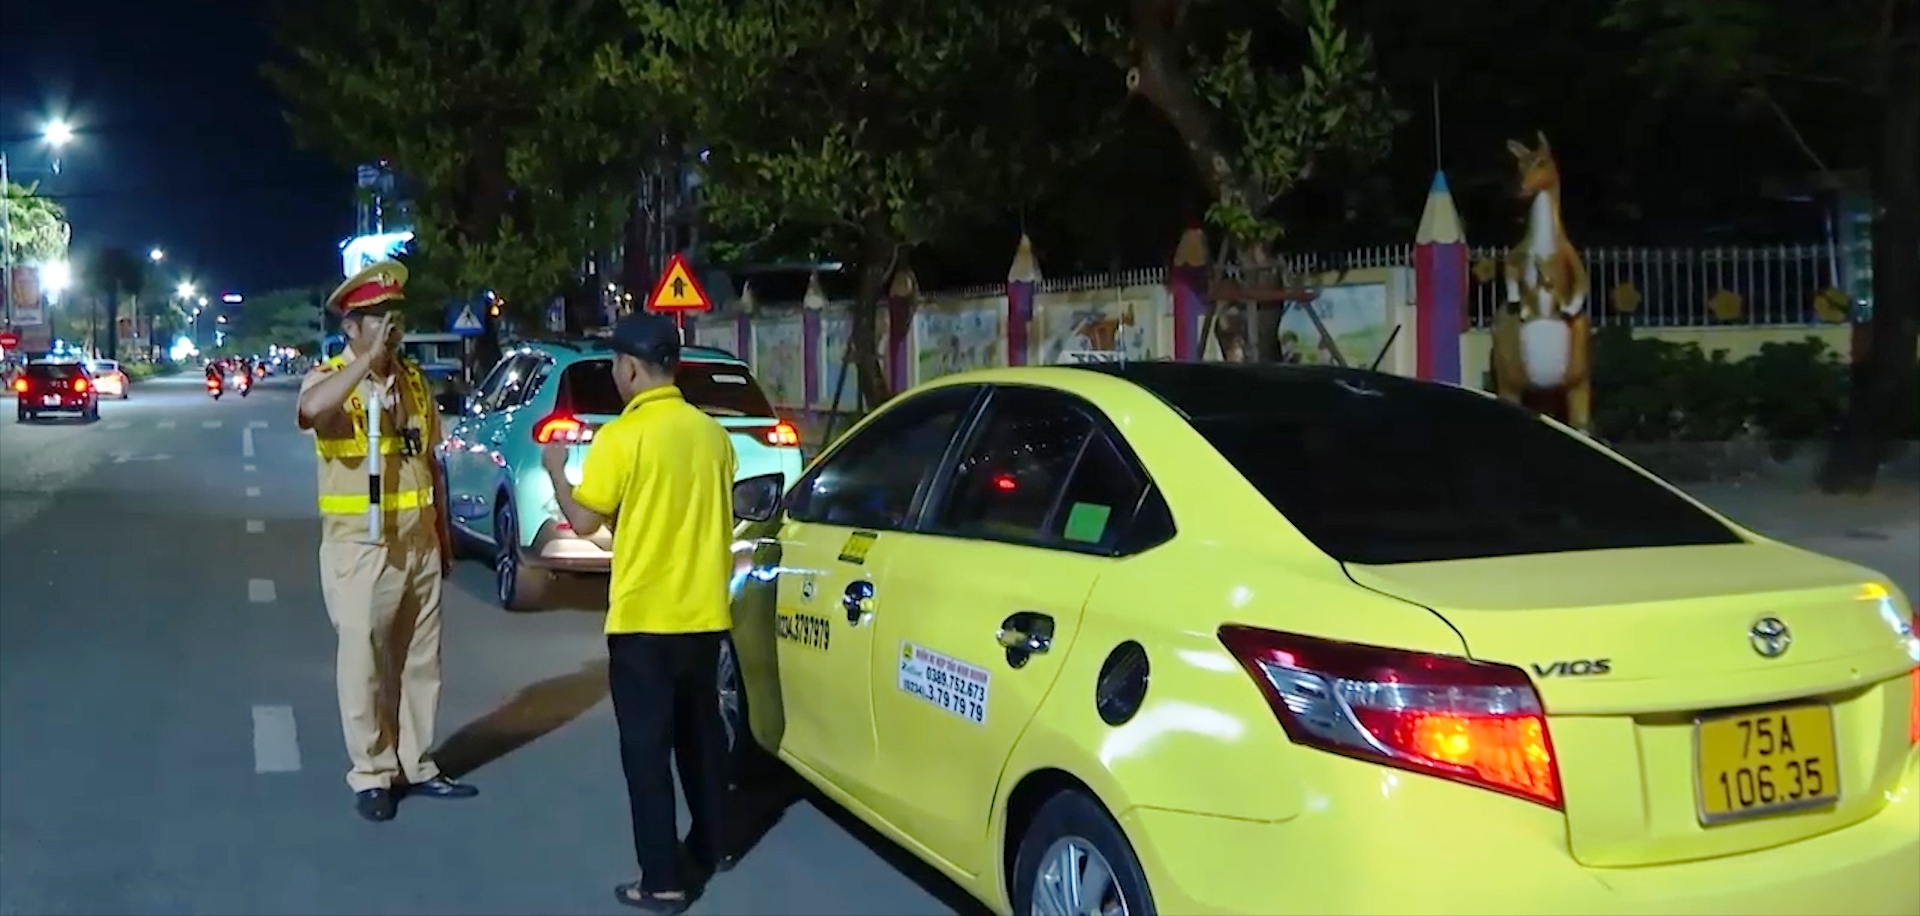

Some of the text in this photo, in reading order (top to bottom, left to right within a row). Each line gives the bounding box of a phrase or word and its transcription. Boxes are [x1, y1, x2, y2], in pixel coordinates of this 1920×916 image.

[1531, 658, 1613, 679] VIOS
[1736, 714, 1796, 760] 75A
[1718, 756, 1825, 812] 106.35
